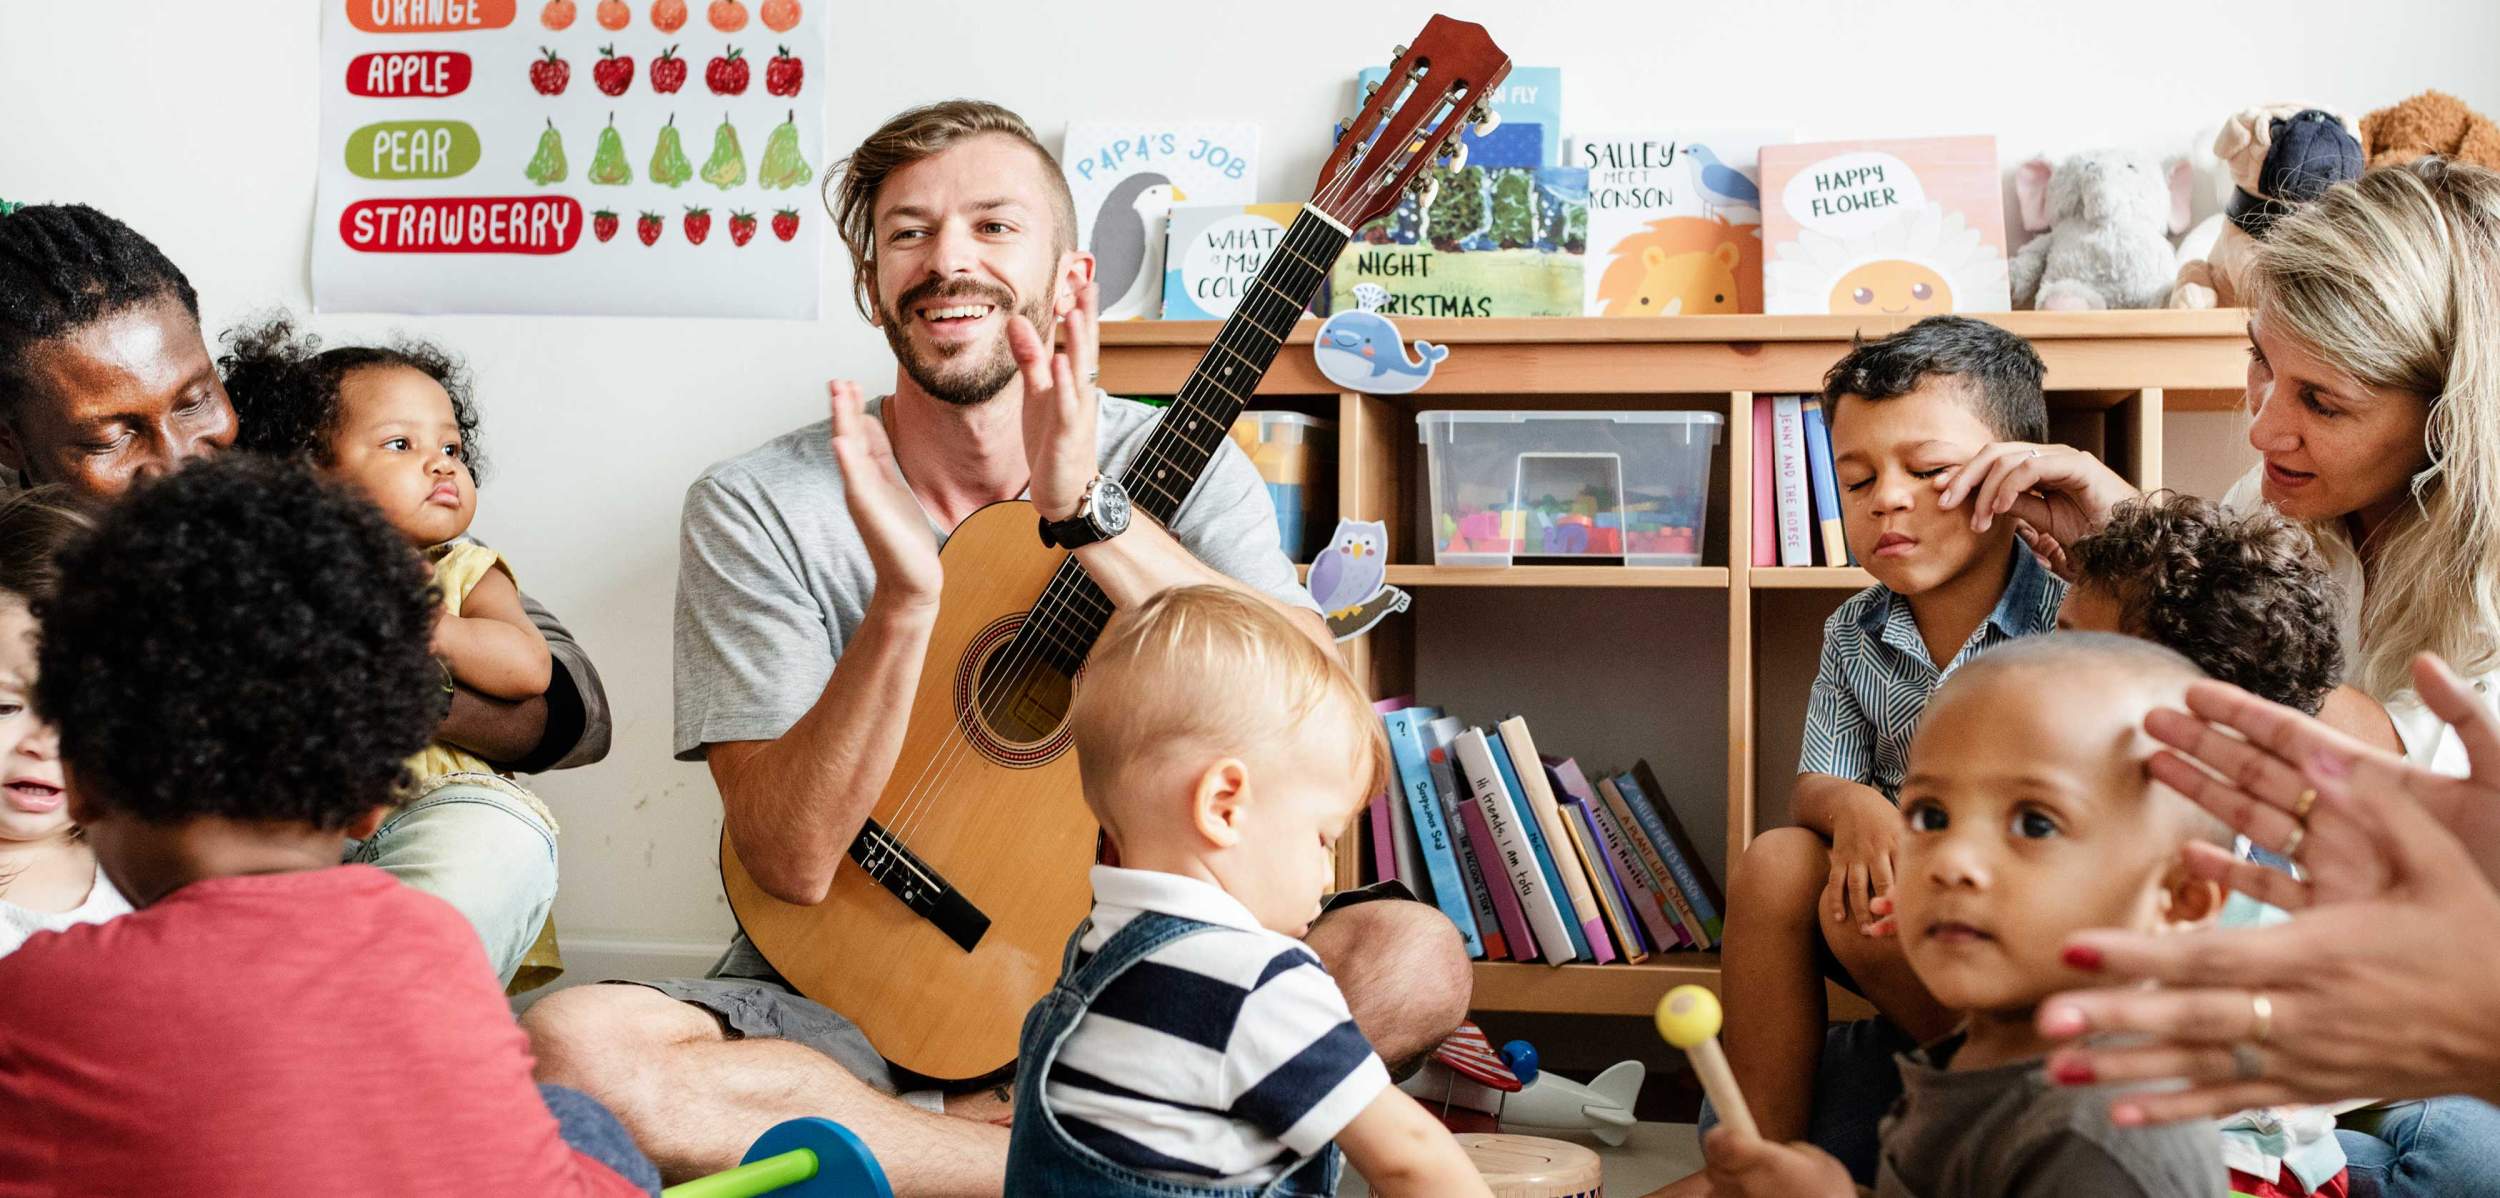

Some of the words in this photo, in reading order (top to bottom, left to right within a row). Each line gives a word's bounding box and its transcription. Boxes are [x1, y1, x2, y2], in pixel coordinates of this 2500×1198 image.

[371, 0, 481, 26] ORANGE
[367, 55, 450, 94] APPLE
[1511, 86, 1539, 105] FLY
[374, 128, 451, 173] PEAR
[1076, 133, 1176, 181] PAPA'S
[1189, 139, 1246, 180] JOB
[1585, 141, 1675, 169] SALLEY
[1603, 171, 1650, 183] MEET
[1815, 165, 1884, 192] HAPPY
[1589, 188, 1673, 208] KONSON
[1812, 188, 1899, 217] FLOWER
[353, 202, 571, 247] STRAWBERRY
[1207, 228, 1279, 249] WHAT
[1225, 252, 1261, 273] MY
[1358, 253, 1433, 277] NIGHT
[1356, 293, 1492, 318] RISTMAS
[1779, 412, 1794, 449] JENNY
[1783, 455, 1796, 478] AND
[1785, 484, 1798, 505] THE
[1787, 510, 1800, 548] HORSE
